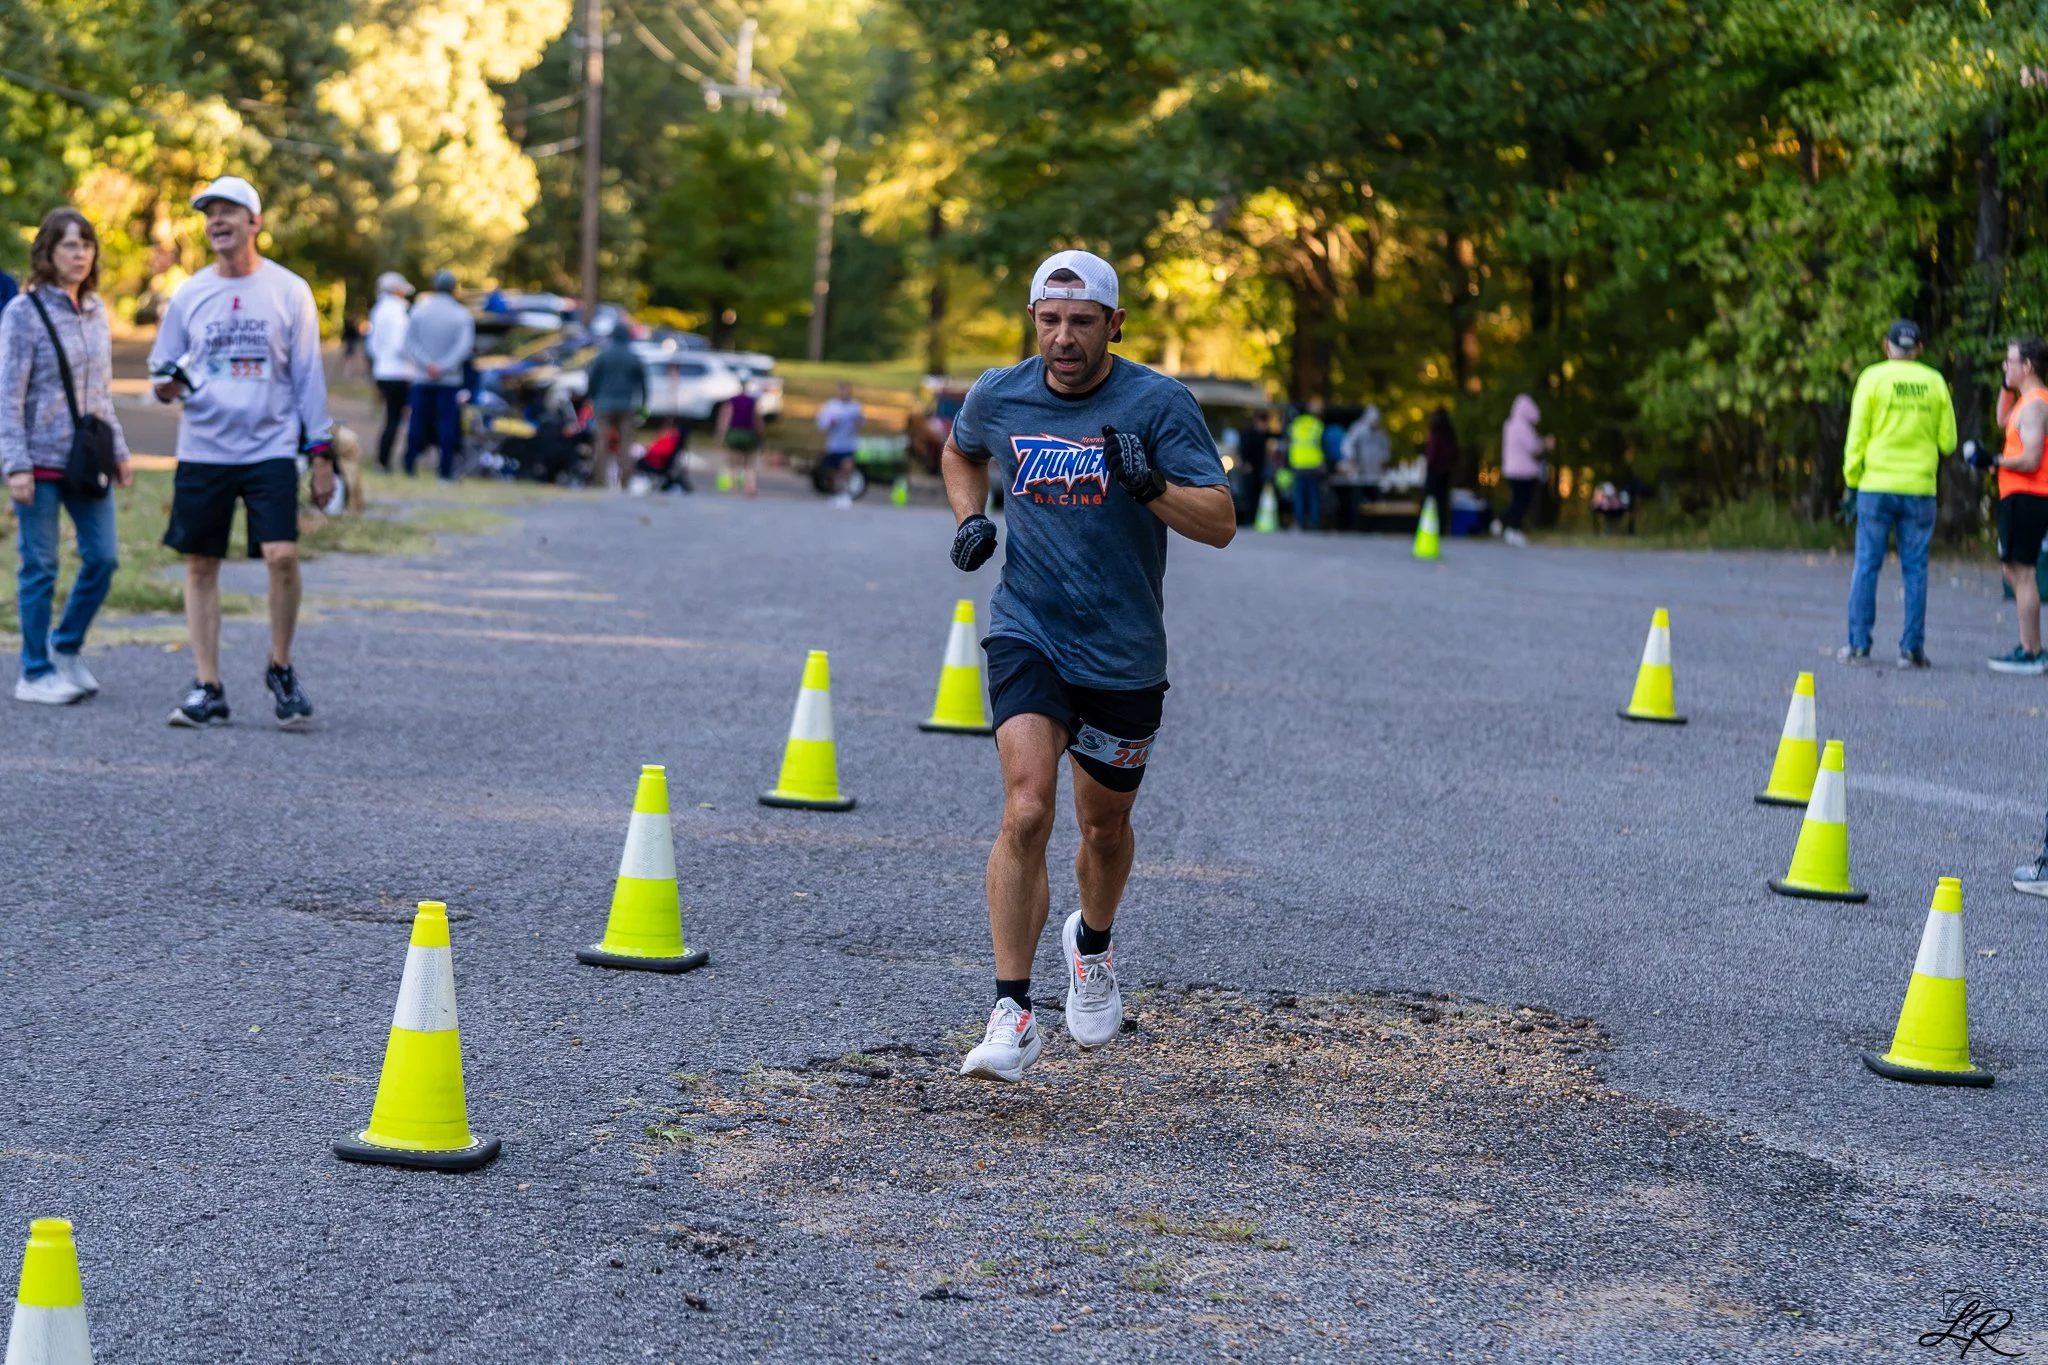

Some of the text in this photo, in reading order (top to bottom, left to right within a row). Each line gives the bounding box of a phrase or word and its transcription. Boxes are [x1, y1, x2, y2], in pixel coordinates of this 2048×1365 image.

[230, 319, 268, 332] JUDE
[205, 335, 269, 347] MEMPHIS
[1034, 493, 1102, 505] RACING
